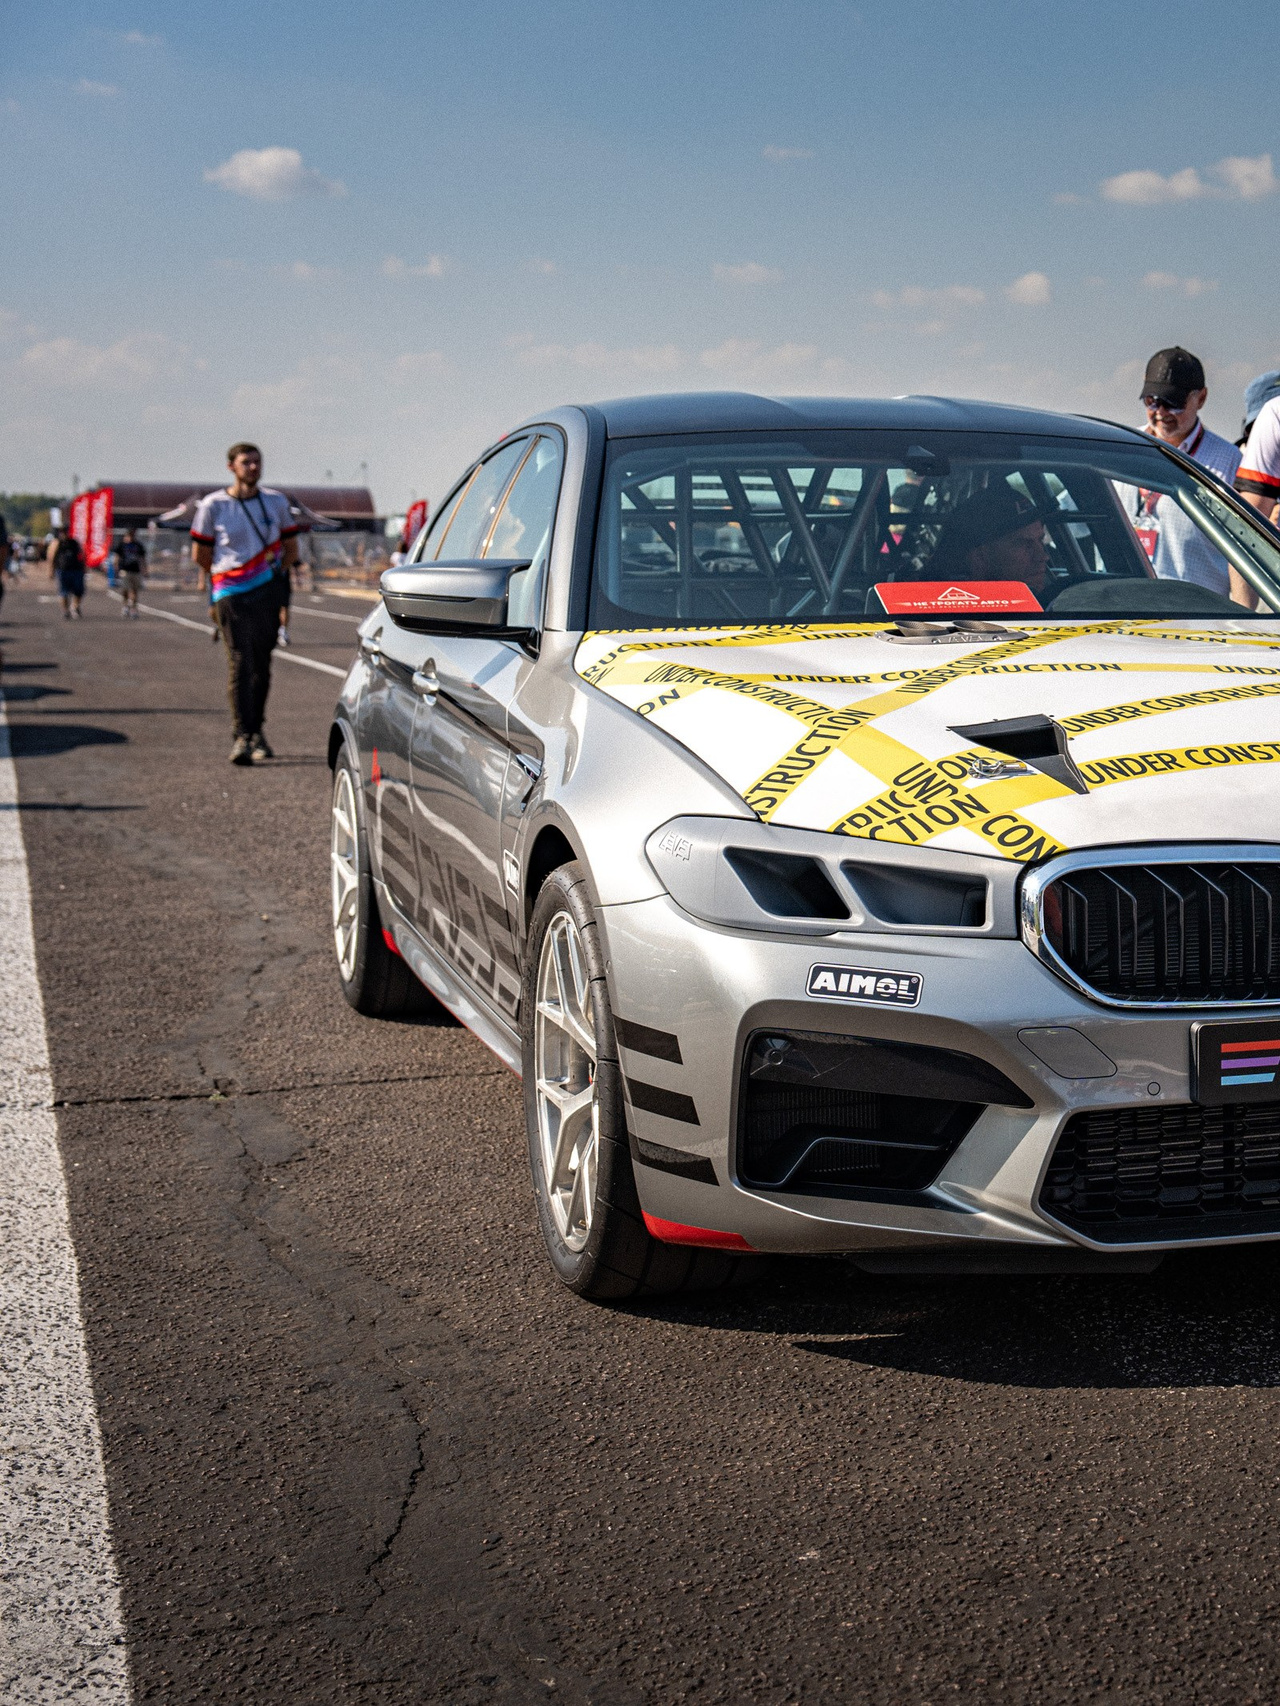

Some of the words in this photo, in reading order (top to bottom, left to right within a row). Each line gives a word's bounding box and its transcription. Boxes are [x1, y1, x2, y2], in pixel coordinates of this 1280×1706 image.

[644, 663, 701, 684] UNDER
[774, 674, 873, 684] UNDER
[896, 667, 964, 694] UNDER
[1062, 704, 1144, 733] UNDER
[1083, 752, 1184, 785] UNDER
[982, 814, 1059, 860] CON
